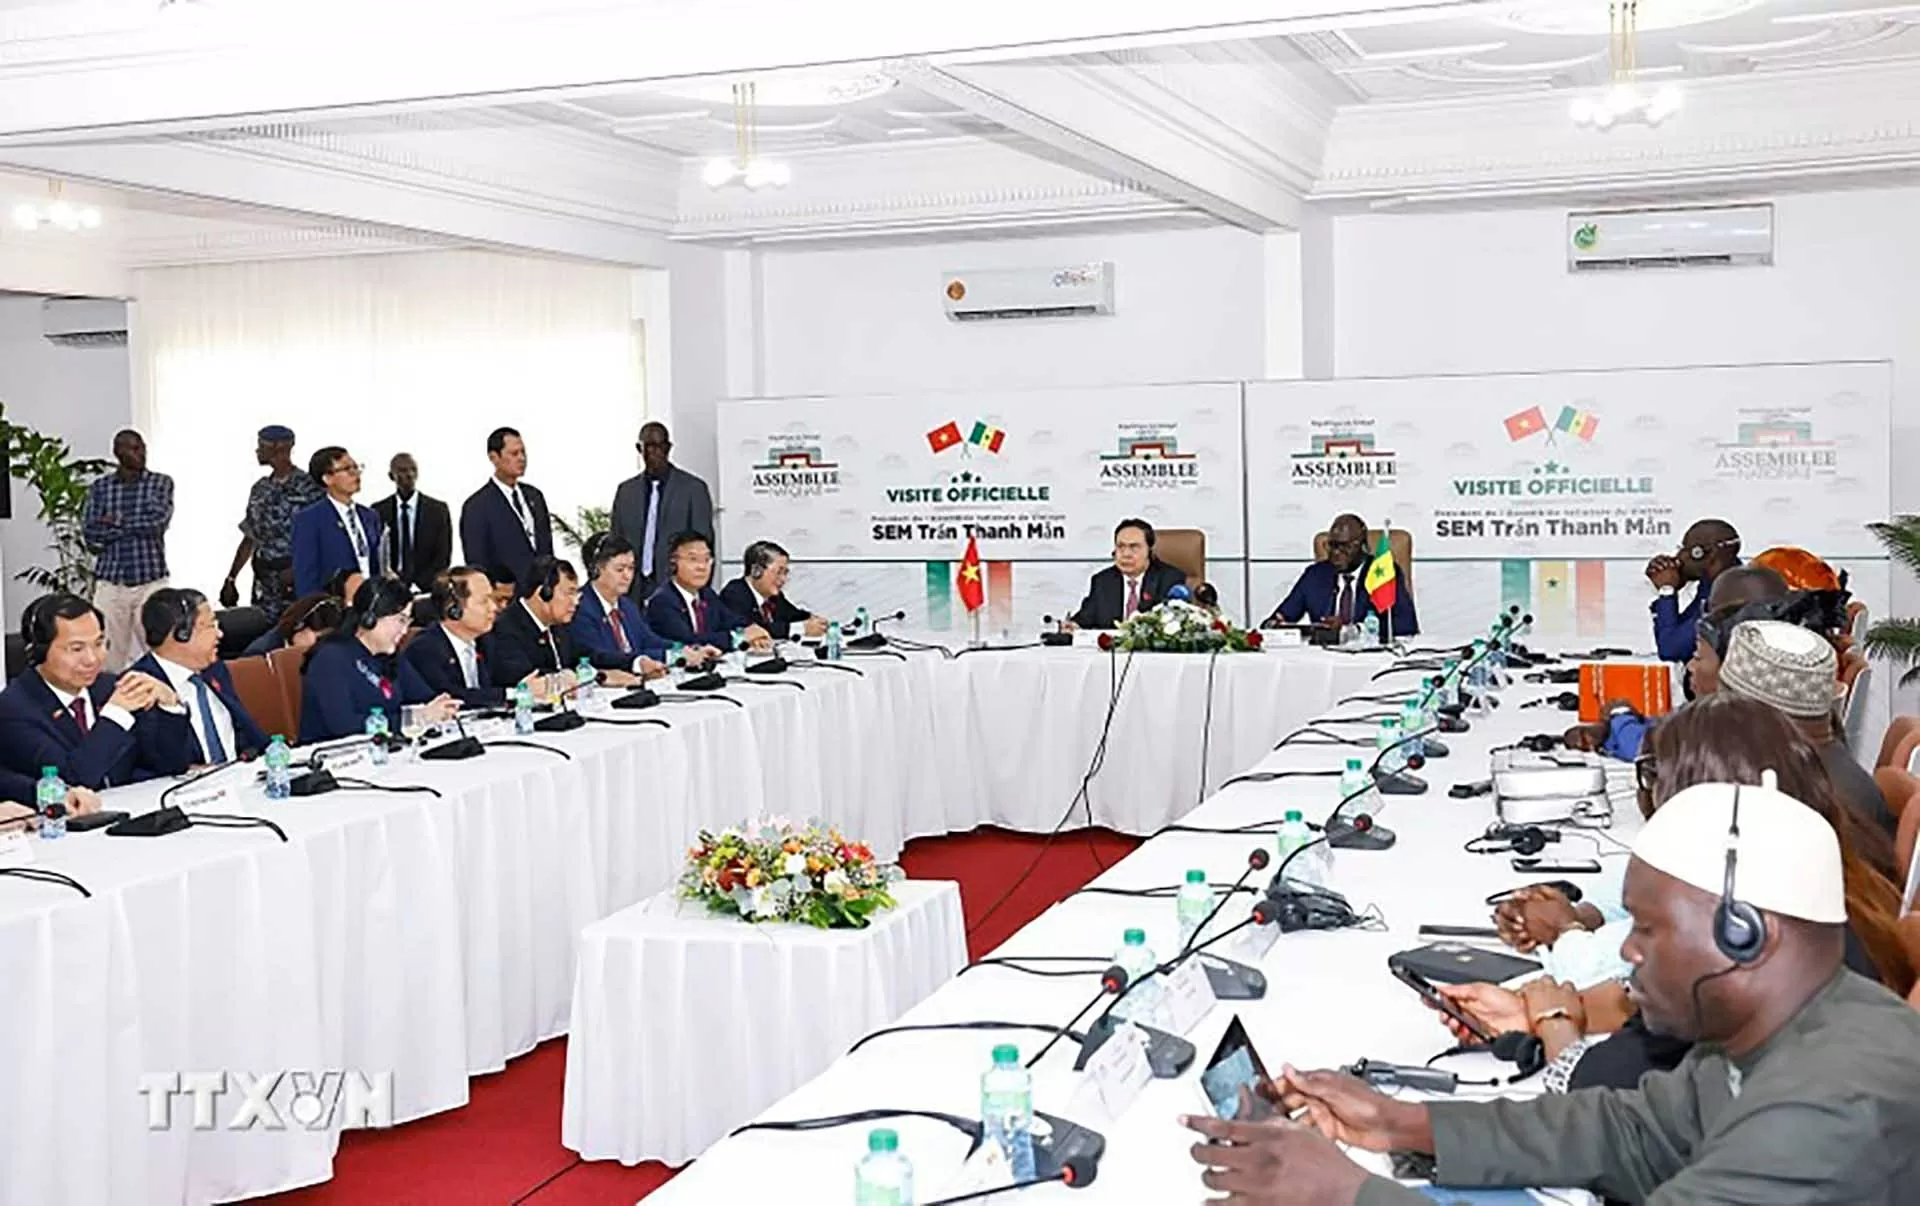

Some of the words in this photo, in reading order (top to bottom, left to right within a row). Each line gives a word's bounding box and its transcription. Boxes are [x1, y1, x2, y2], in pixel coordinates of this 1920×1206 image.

[886, 488, 942, 503] VISITE
[947, 486, 1050, 502] OFFICIELLE
[1453, 479, 1522, 495] VISITE
[1527, 477, 1653, 494] OFFICIELLE
[872, 524, 912, 540] SEM
[962, 522, 1022, 539] Thanh
[1436, 519, 1484, 537] SEM
[1545, 518, 1618, 536] Thanh
